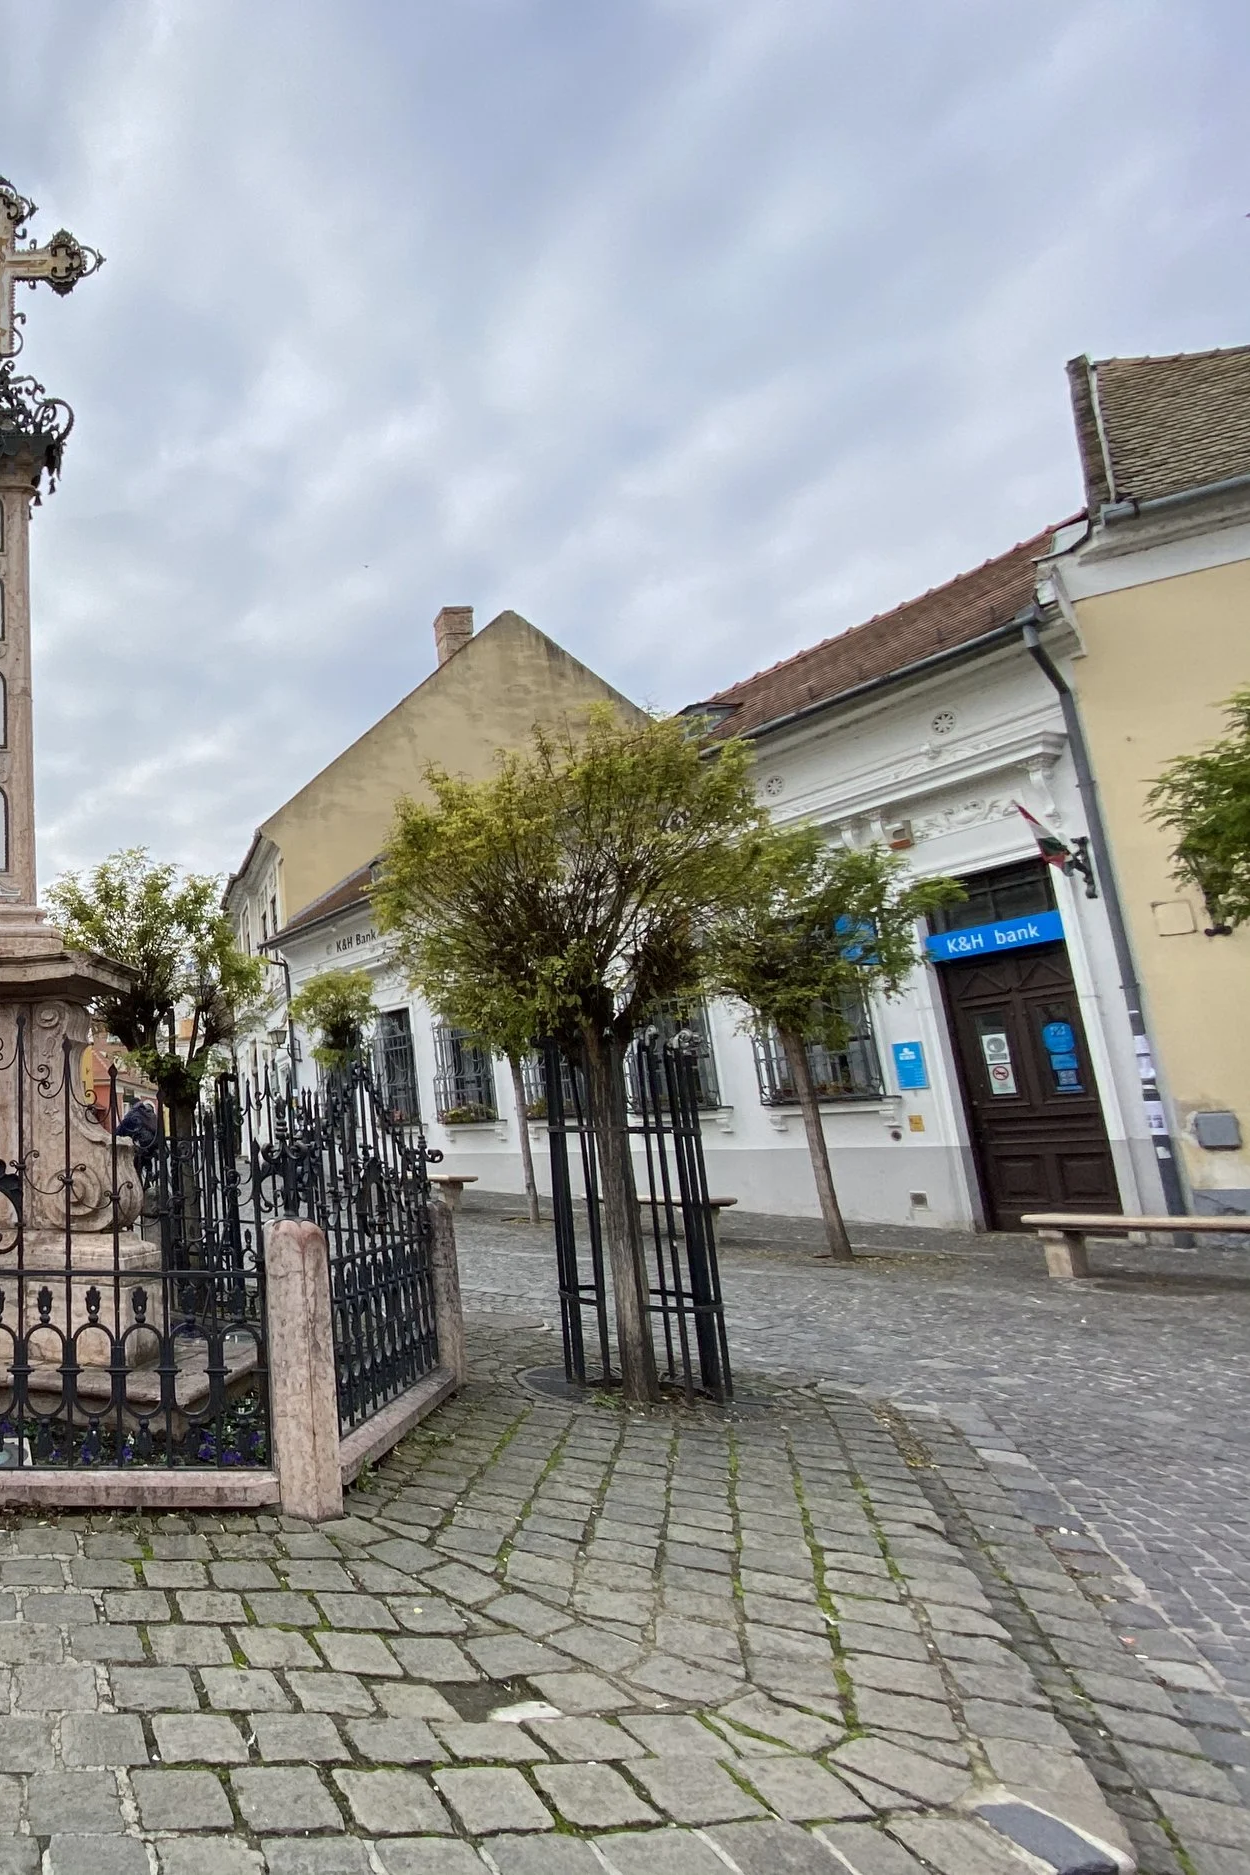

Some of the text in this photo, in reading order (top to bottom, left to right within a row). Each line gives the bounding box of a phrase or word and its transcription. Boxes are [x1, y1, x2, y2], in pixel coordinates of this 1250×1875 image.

[336, 929, 376, 952] K&H Bank
[947, 922, 1040, 953] K&H bank
